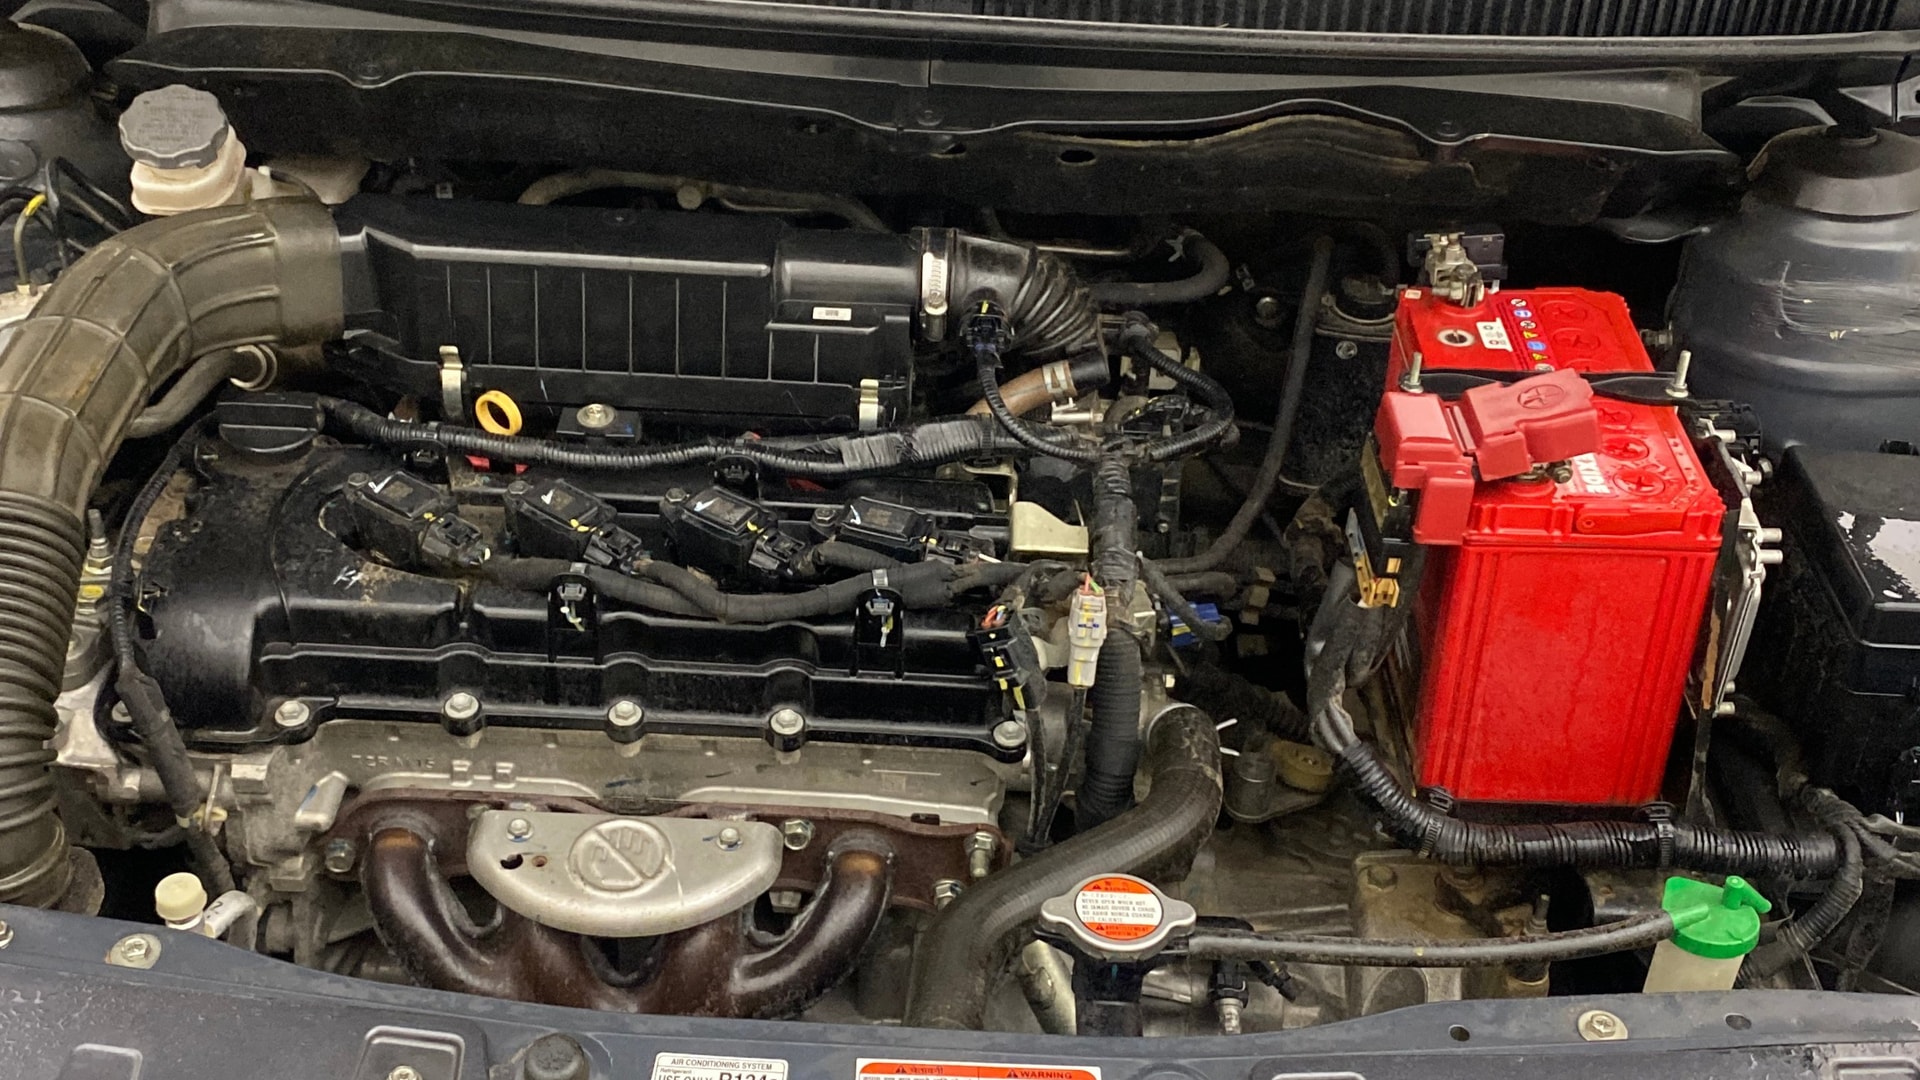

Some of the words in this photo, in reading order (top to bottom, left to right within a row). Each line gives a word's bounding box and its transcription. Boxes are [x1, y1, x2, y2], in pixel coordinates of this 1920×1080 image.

[671, 1058, 684, 1066] AIR
[685, 1059, 740, 1069] CONDITIONING
[741, 1062, 773, 1070] SYSTEM
[1020, 1070, 1072, 1079] WARNING
